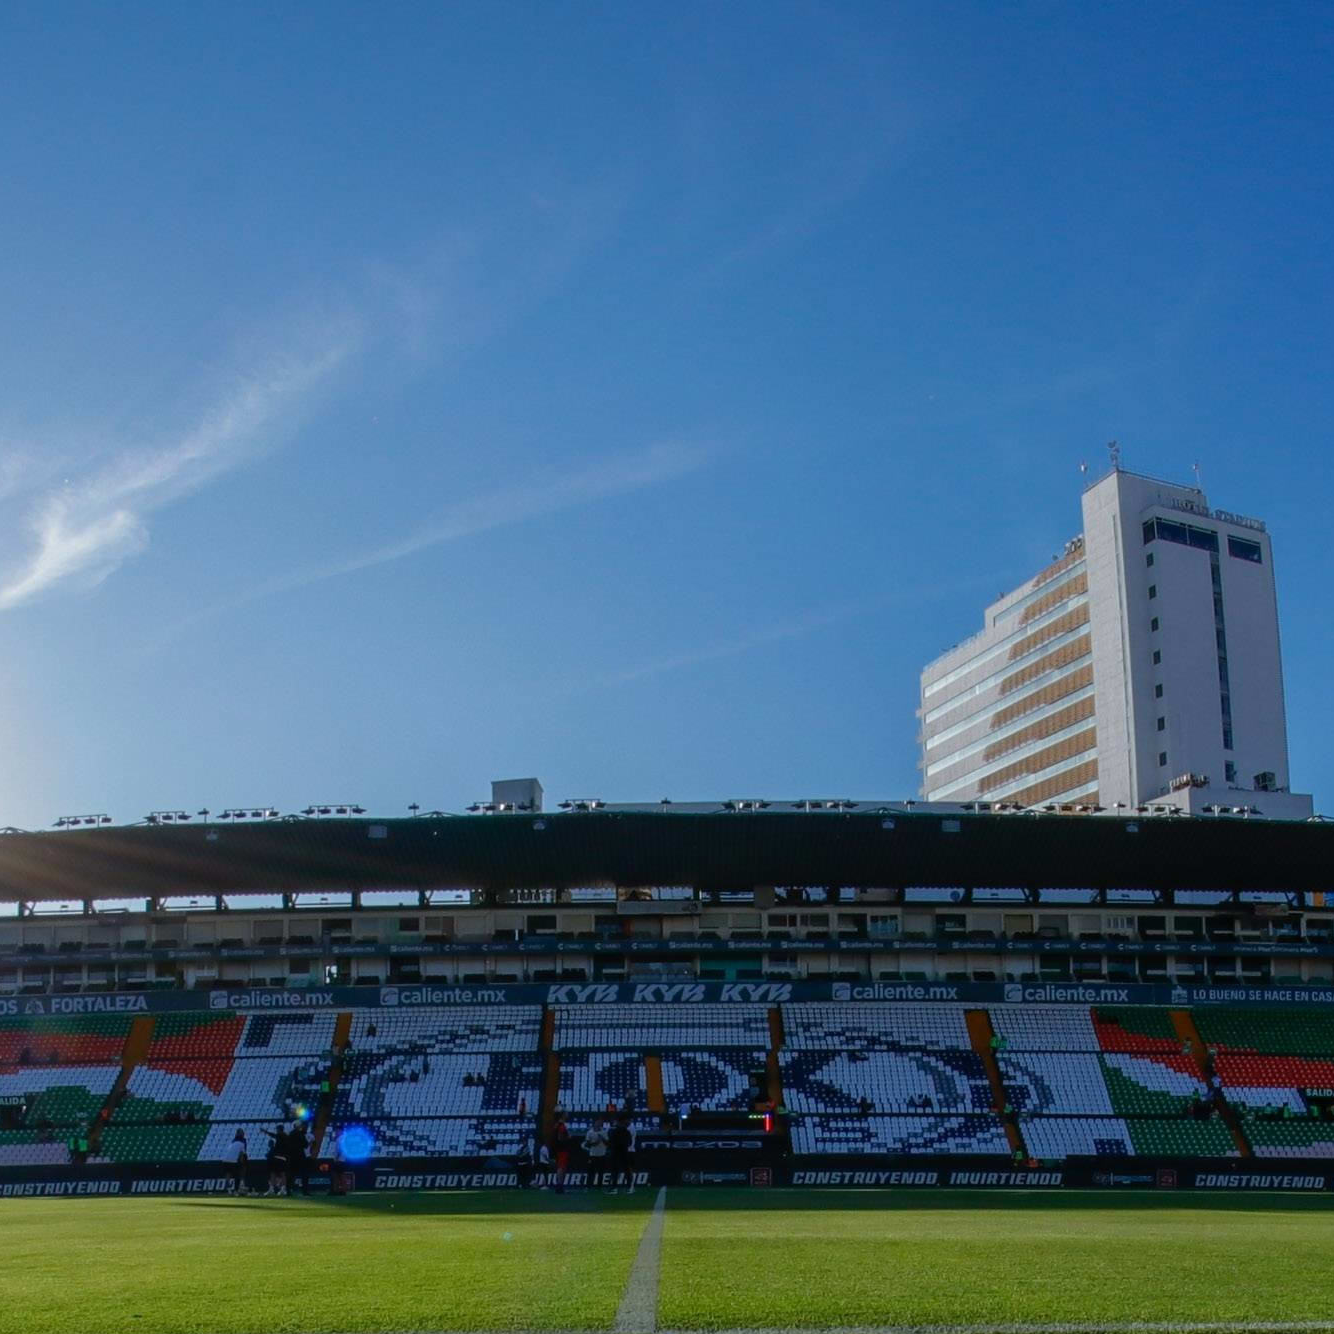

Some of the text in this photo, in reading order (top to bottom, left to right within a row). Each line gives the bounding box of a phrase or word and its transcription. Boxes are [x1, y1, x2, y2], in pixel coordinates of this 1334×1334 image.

[230, 990, 333, 1006] caliente.mx
[400, 987, 505, 1004] caliente.mx
[547, 984, 619, 1003] KYB
[633, 984, 706, 1002] KYB
[720, 984, 793, 1001] KYB
[853, 984, 957, 1000] caliente.mx
[1025, 985, 1129, 1001] caliente.mx
[1193, 989, 1207, 1000] LO
[1209, 989, 1247, 1000] BUENO
[1250, 990, 1262, 1000] SE
[1265, 990, 1291, 1001] HACE
[1294, 991, 1309, 1001] EN
[51, 995, 147, 1014] FORTALEZA
